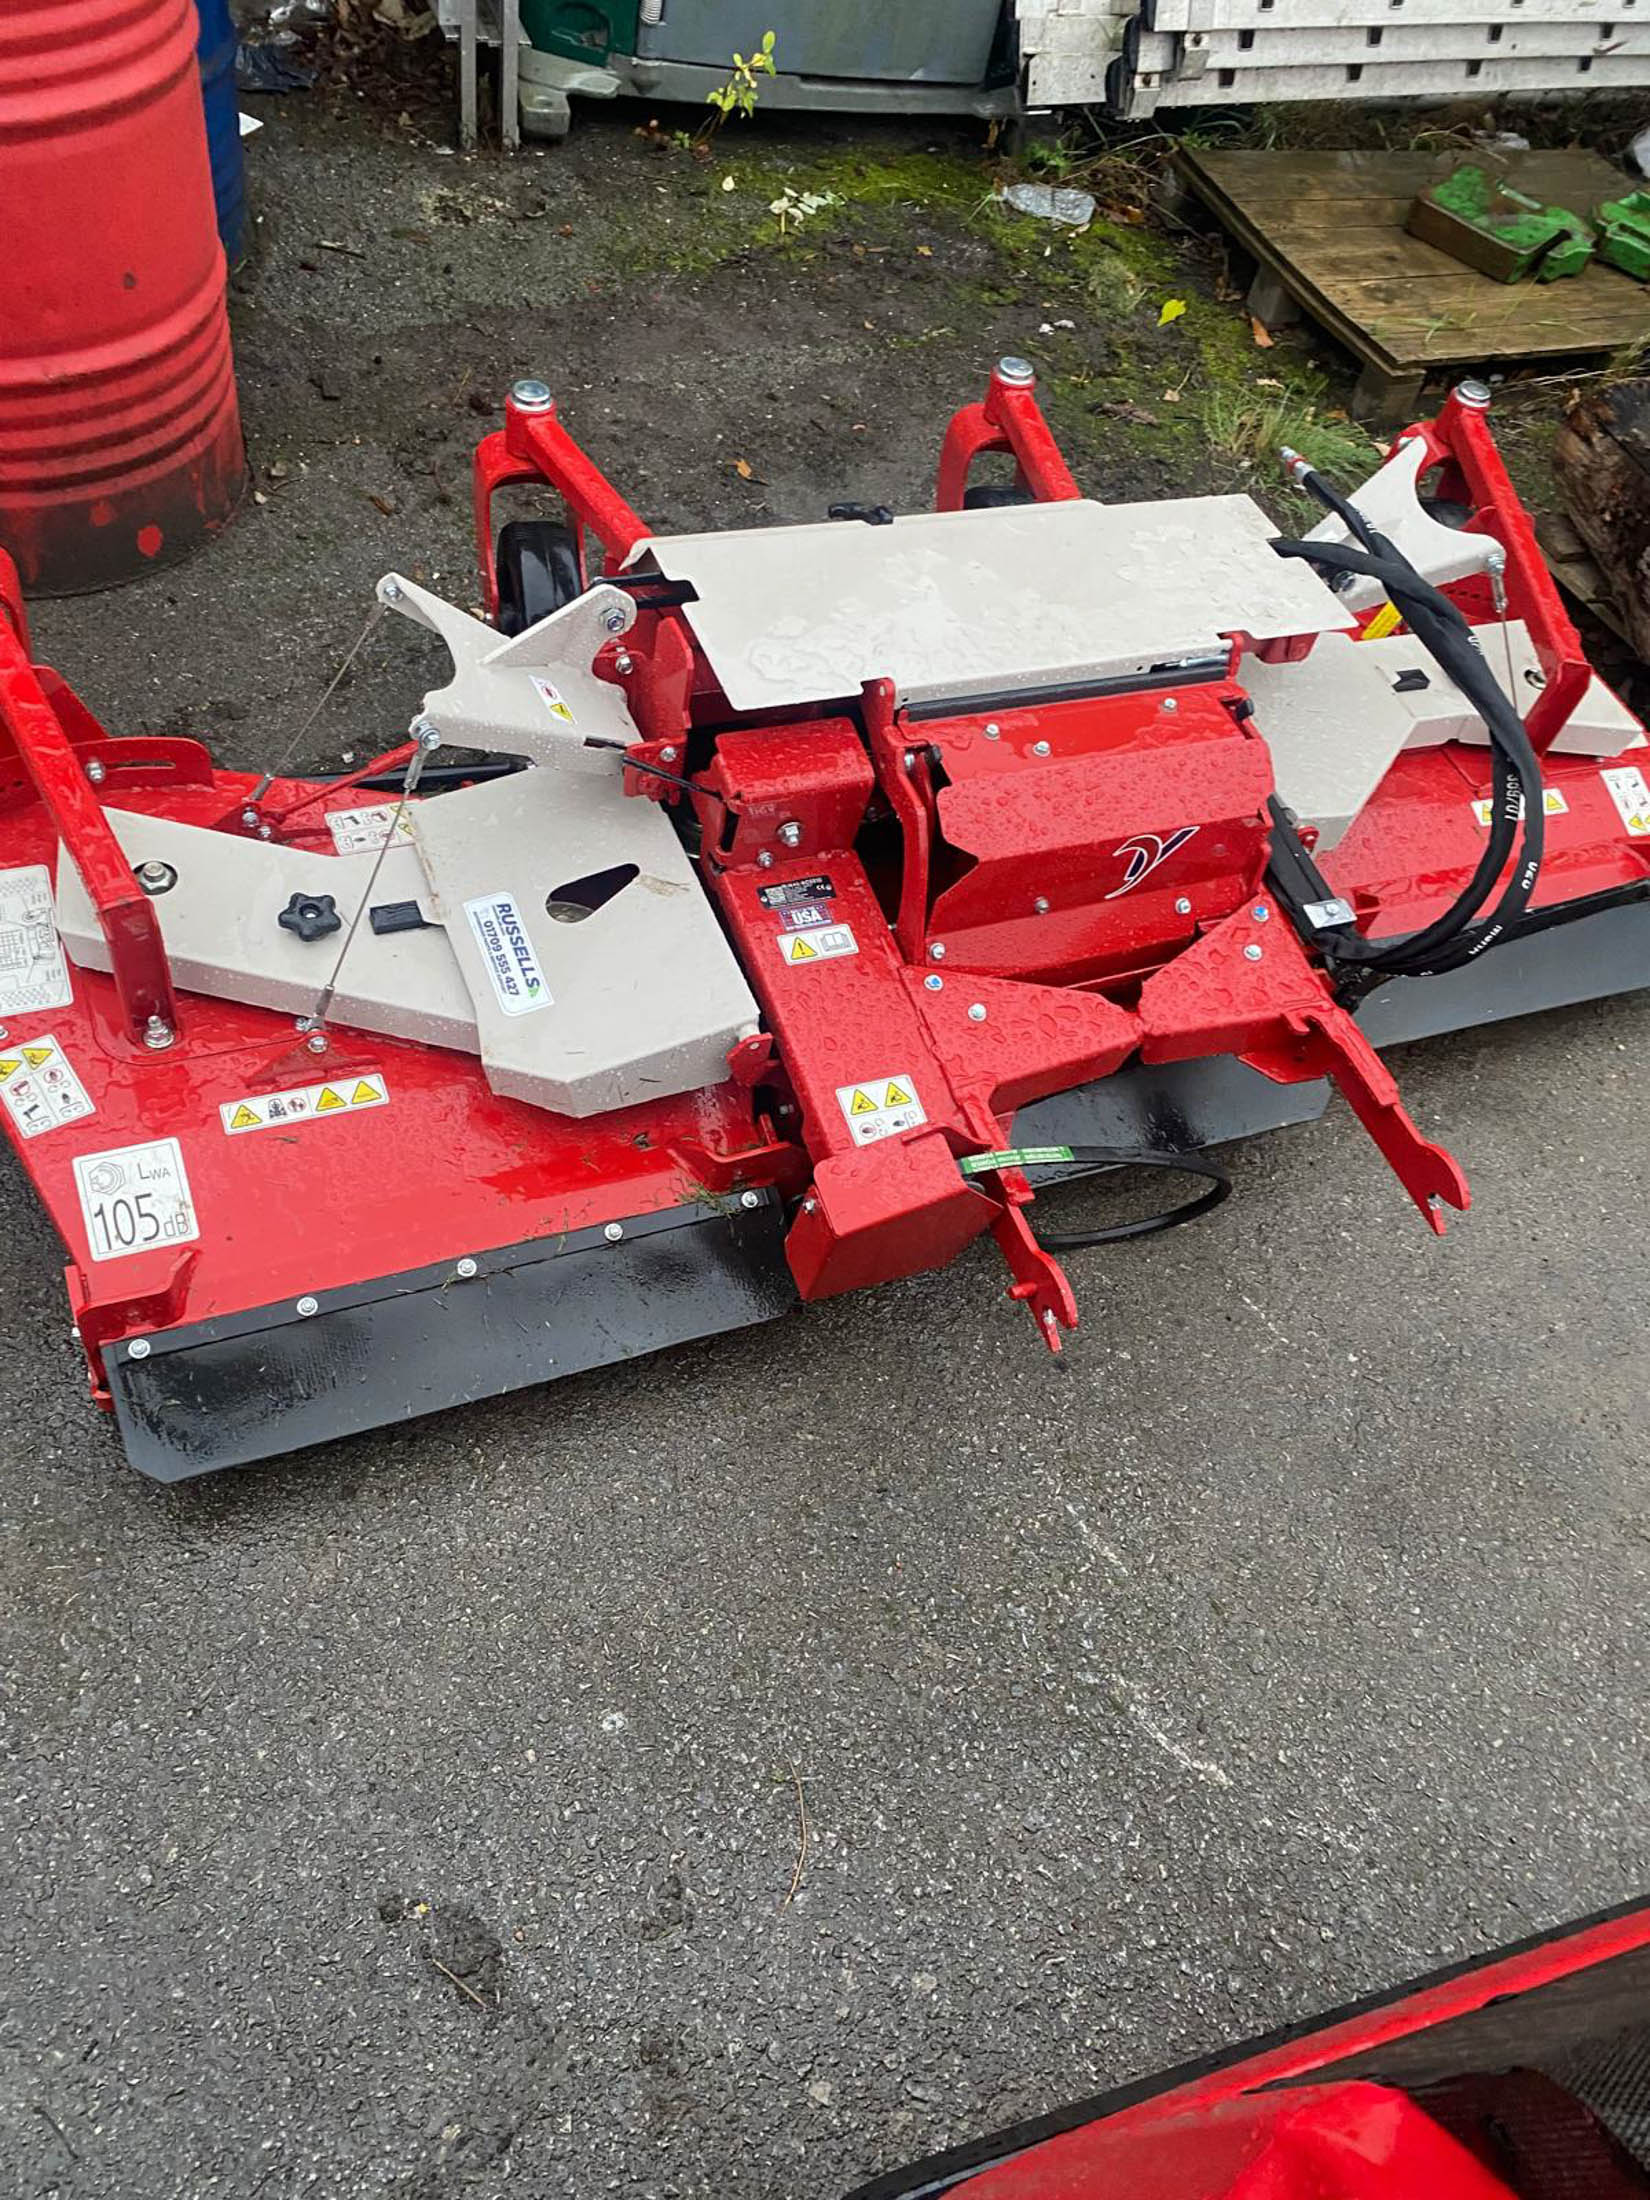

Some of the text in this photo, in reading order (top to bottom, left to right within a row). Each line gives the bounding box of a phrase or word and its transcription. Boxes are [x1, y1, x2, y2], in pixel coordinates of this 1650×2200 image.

[496, 903, 540, 988] RUSSELLS
[791, 906, 823, 924] USA
[483, 920, 502, 952] 01709
[496, 953, 512, 975] 555
[505, 975, 520, 996] 427
[94, 1193, 189, 1250] 105 dB
